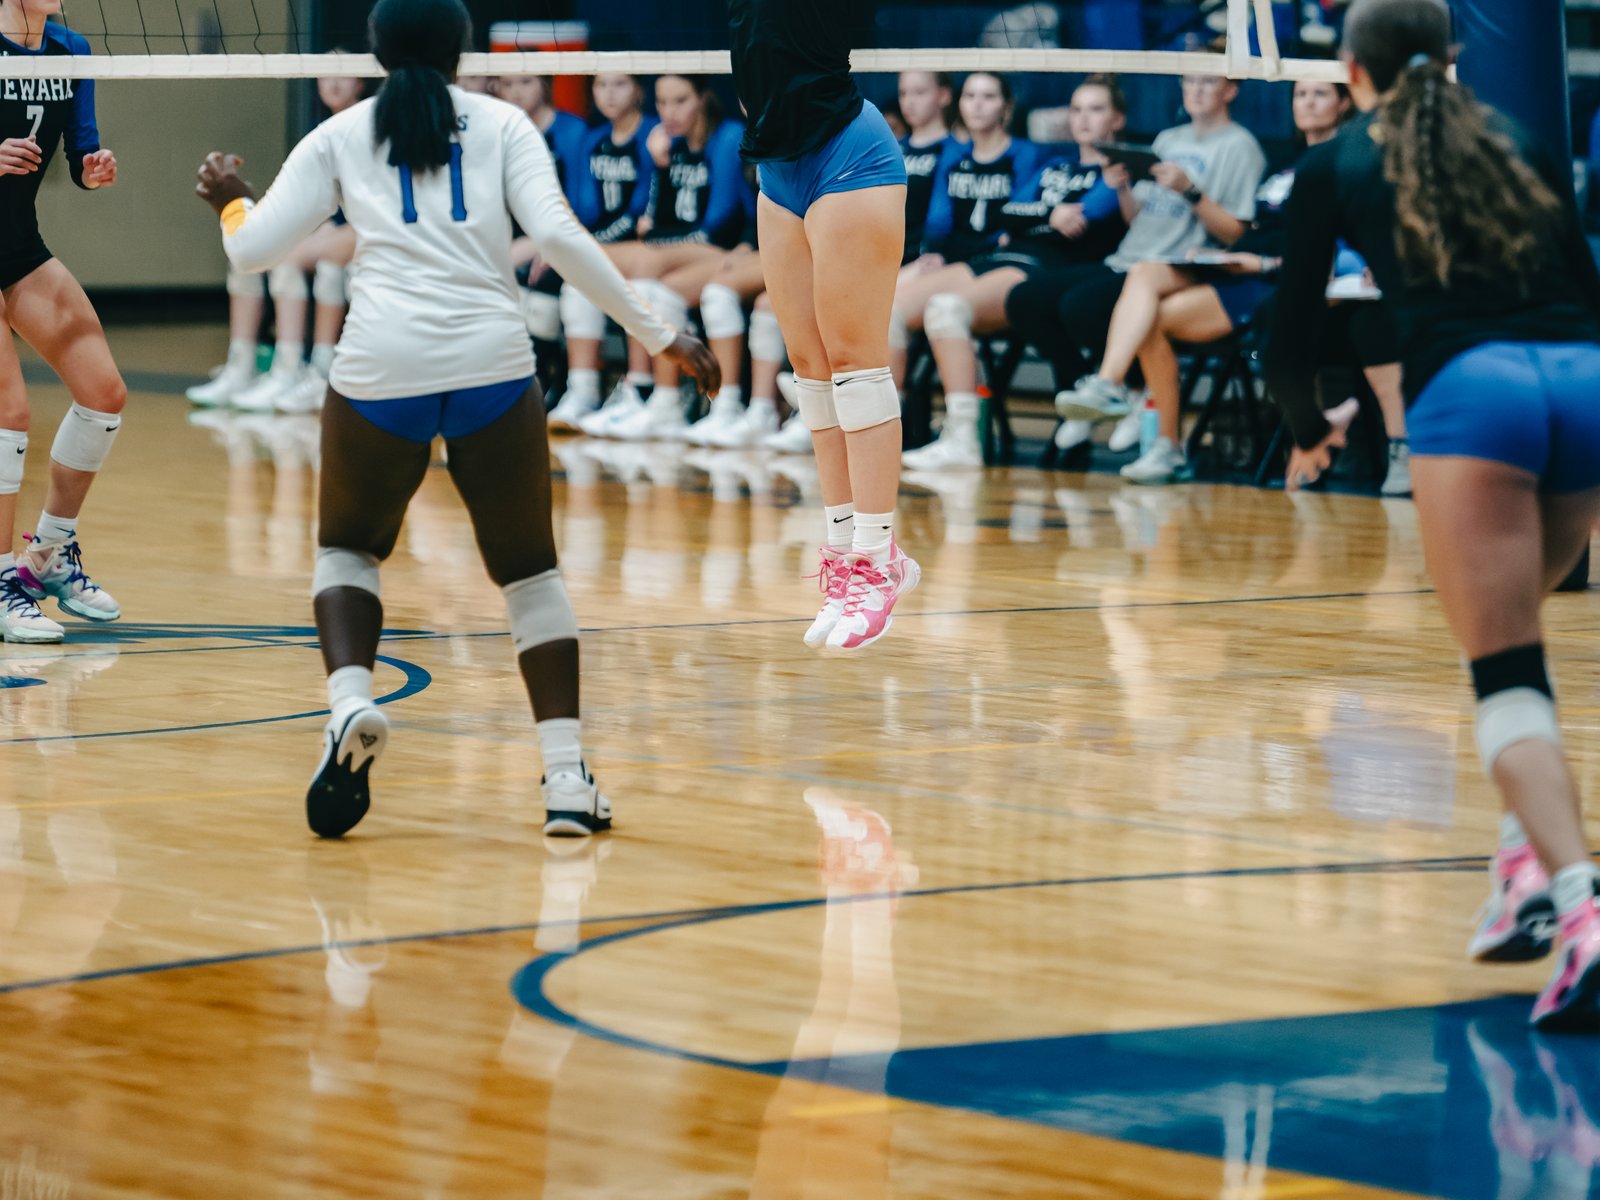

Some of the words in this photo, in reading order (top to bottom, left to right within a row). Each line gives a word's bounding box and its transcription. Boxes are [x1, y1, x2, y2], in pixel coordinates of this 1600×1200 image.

[0, 79, 74, 101] EWARK
[26, 104, 44, 137] 7
[398, 142, 467, 223] 11
